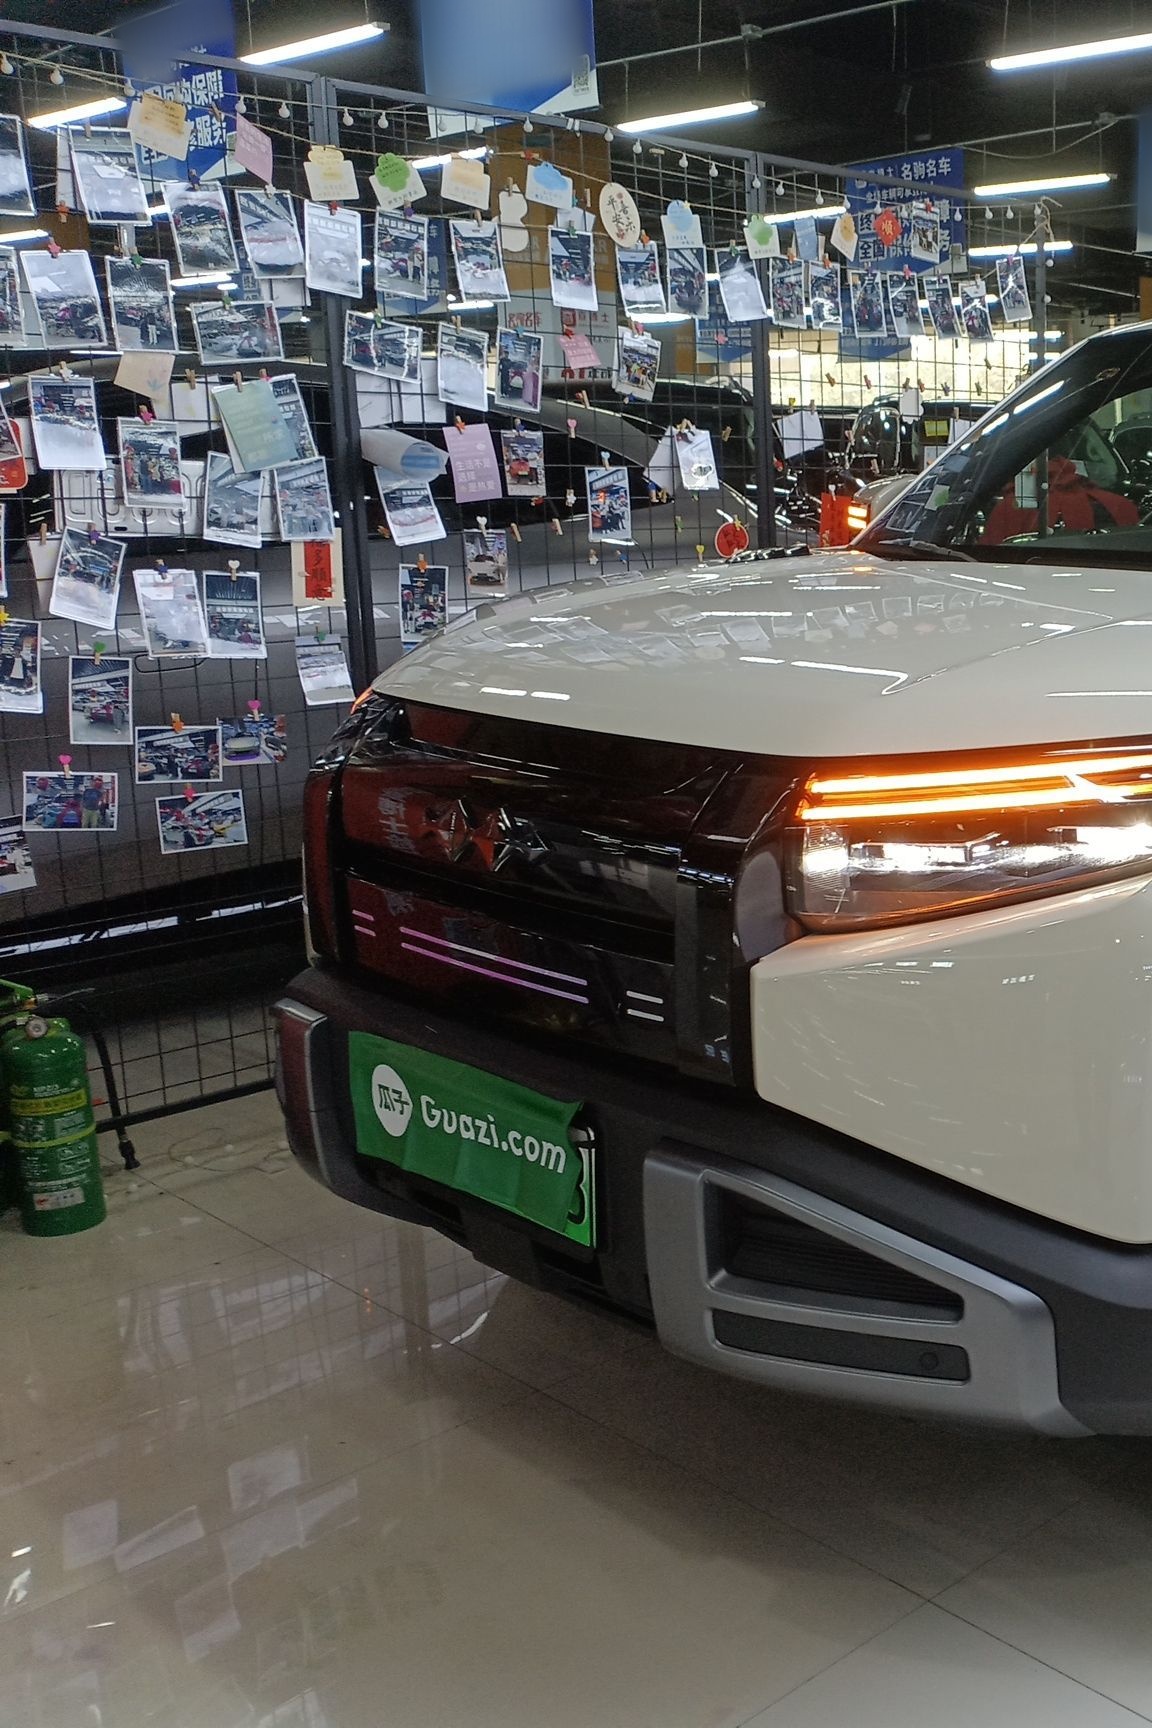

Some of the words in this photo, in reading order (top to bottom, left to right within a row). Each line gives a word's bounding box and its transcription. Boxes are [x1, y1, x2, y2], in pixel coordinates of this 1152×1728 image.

[901, 157, 951, 181] 名驹名车
[377, 1084, 410, 1116] 瓜子
[420, 1095, 567, 1174] Guazi.com
